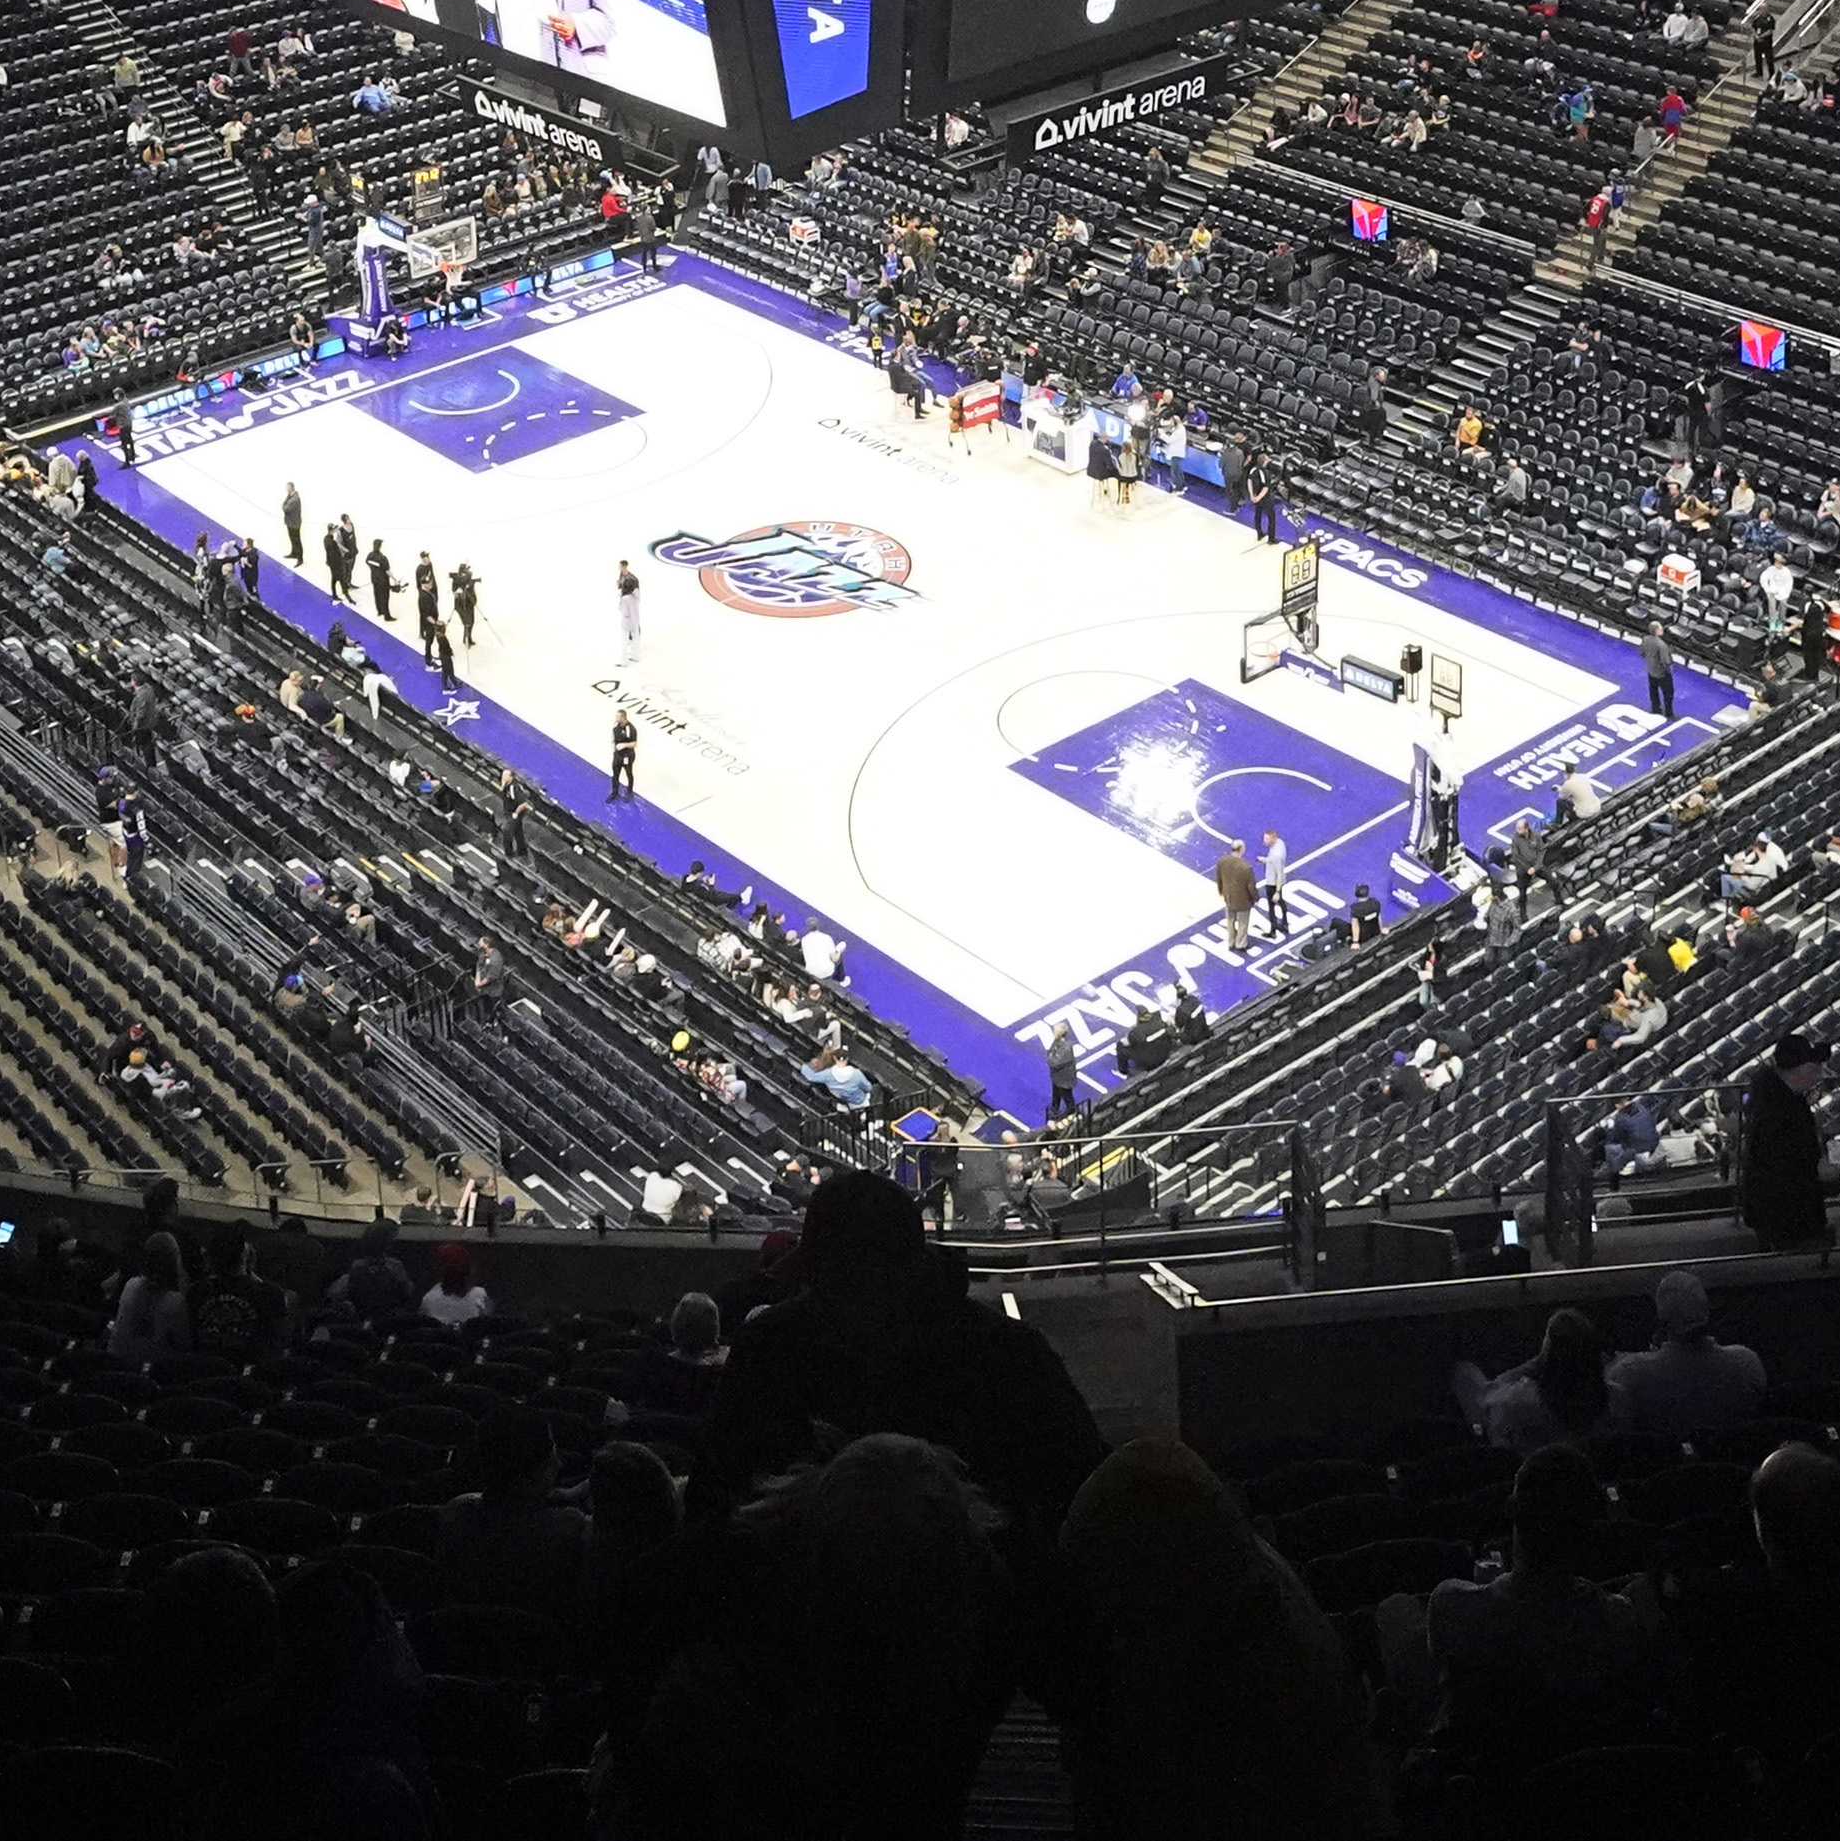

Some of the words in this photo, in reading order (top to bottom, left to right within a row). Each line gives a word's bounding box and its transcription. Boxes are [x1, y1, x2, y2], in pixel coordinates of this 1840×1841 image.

[492, 96, 547, 143] vivint
[550, 123, 603, 161] arena
[1061, 96, 1136, 141] vivint
[1139, 74, 1206, 116] arena
[573, 275, 659, 310] HEALTH
[108, 417, 234, 464] UTAH
[269, 368, 376, 416] JAZZ
[839, 425, 902, 458] vivint
[896, 455, 960, 486] arena
[1319, 537, 1428, 589] PACS
[616, 692, 689, 735] vivint
[678, 732, 750, 776] arena
[1507, 729, 1616, 791] HEALTH
